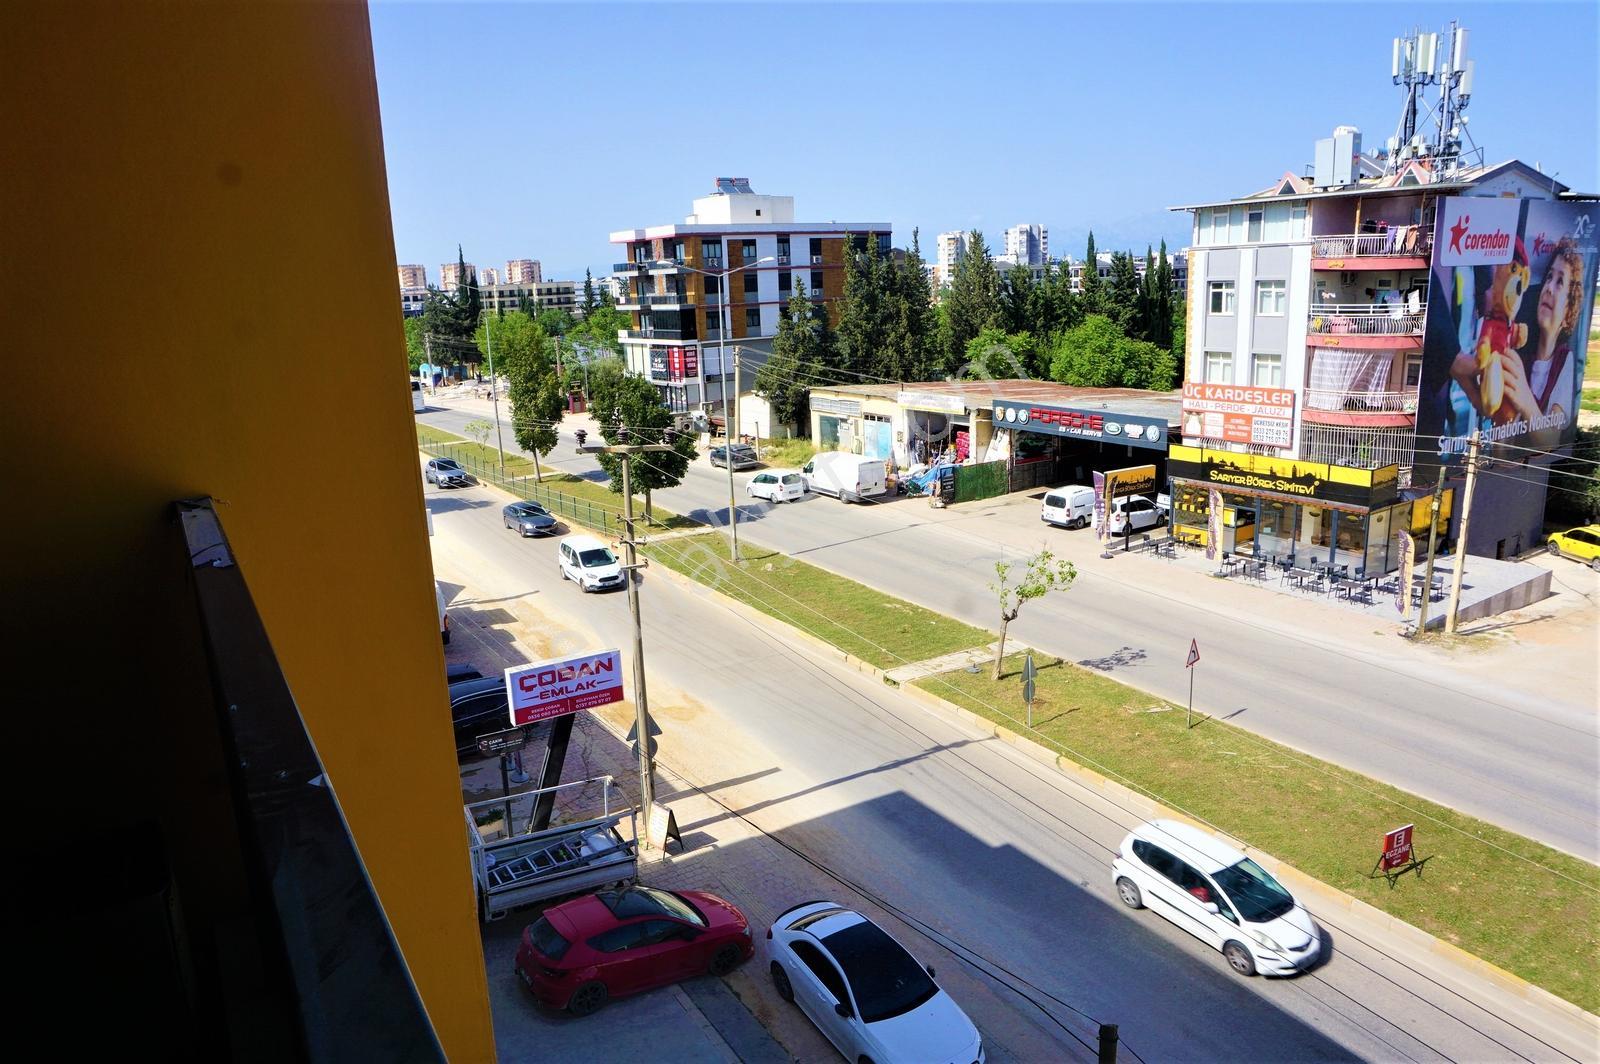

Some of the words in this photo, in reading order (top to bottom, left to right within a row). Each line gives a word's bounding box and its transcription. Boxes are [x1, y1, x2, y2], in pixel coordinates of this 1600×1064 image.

[1465, 228, 1510, 250] corendon
[1184, 383, 1202, 398] ÜÇ
[1029, 408, 1104, 430] PORSCHE
[1215, 403, 1246, 413] PERDE
[1475, 418, 1528, 444] estinations
[518, 657, 613, 693] ÇOBAN
[539, 679, 598, 701] EMLAK
[1386, 844, 1410, 859] ECZANE
